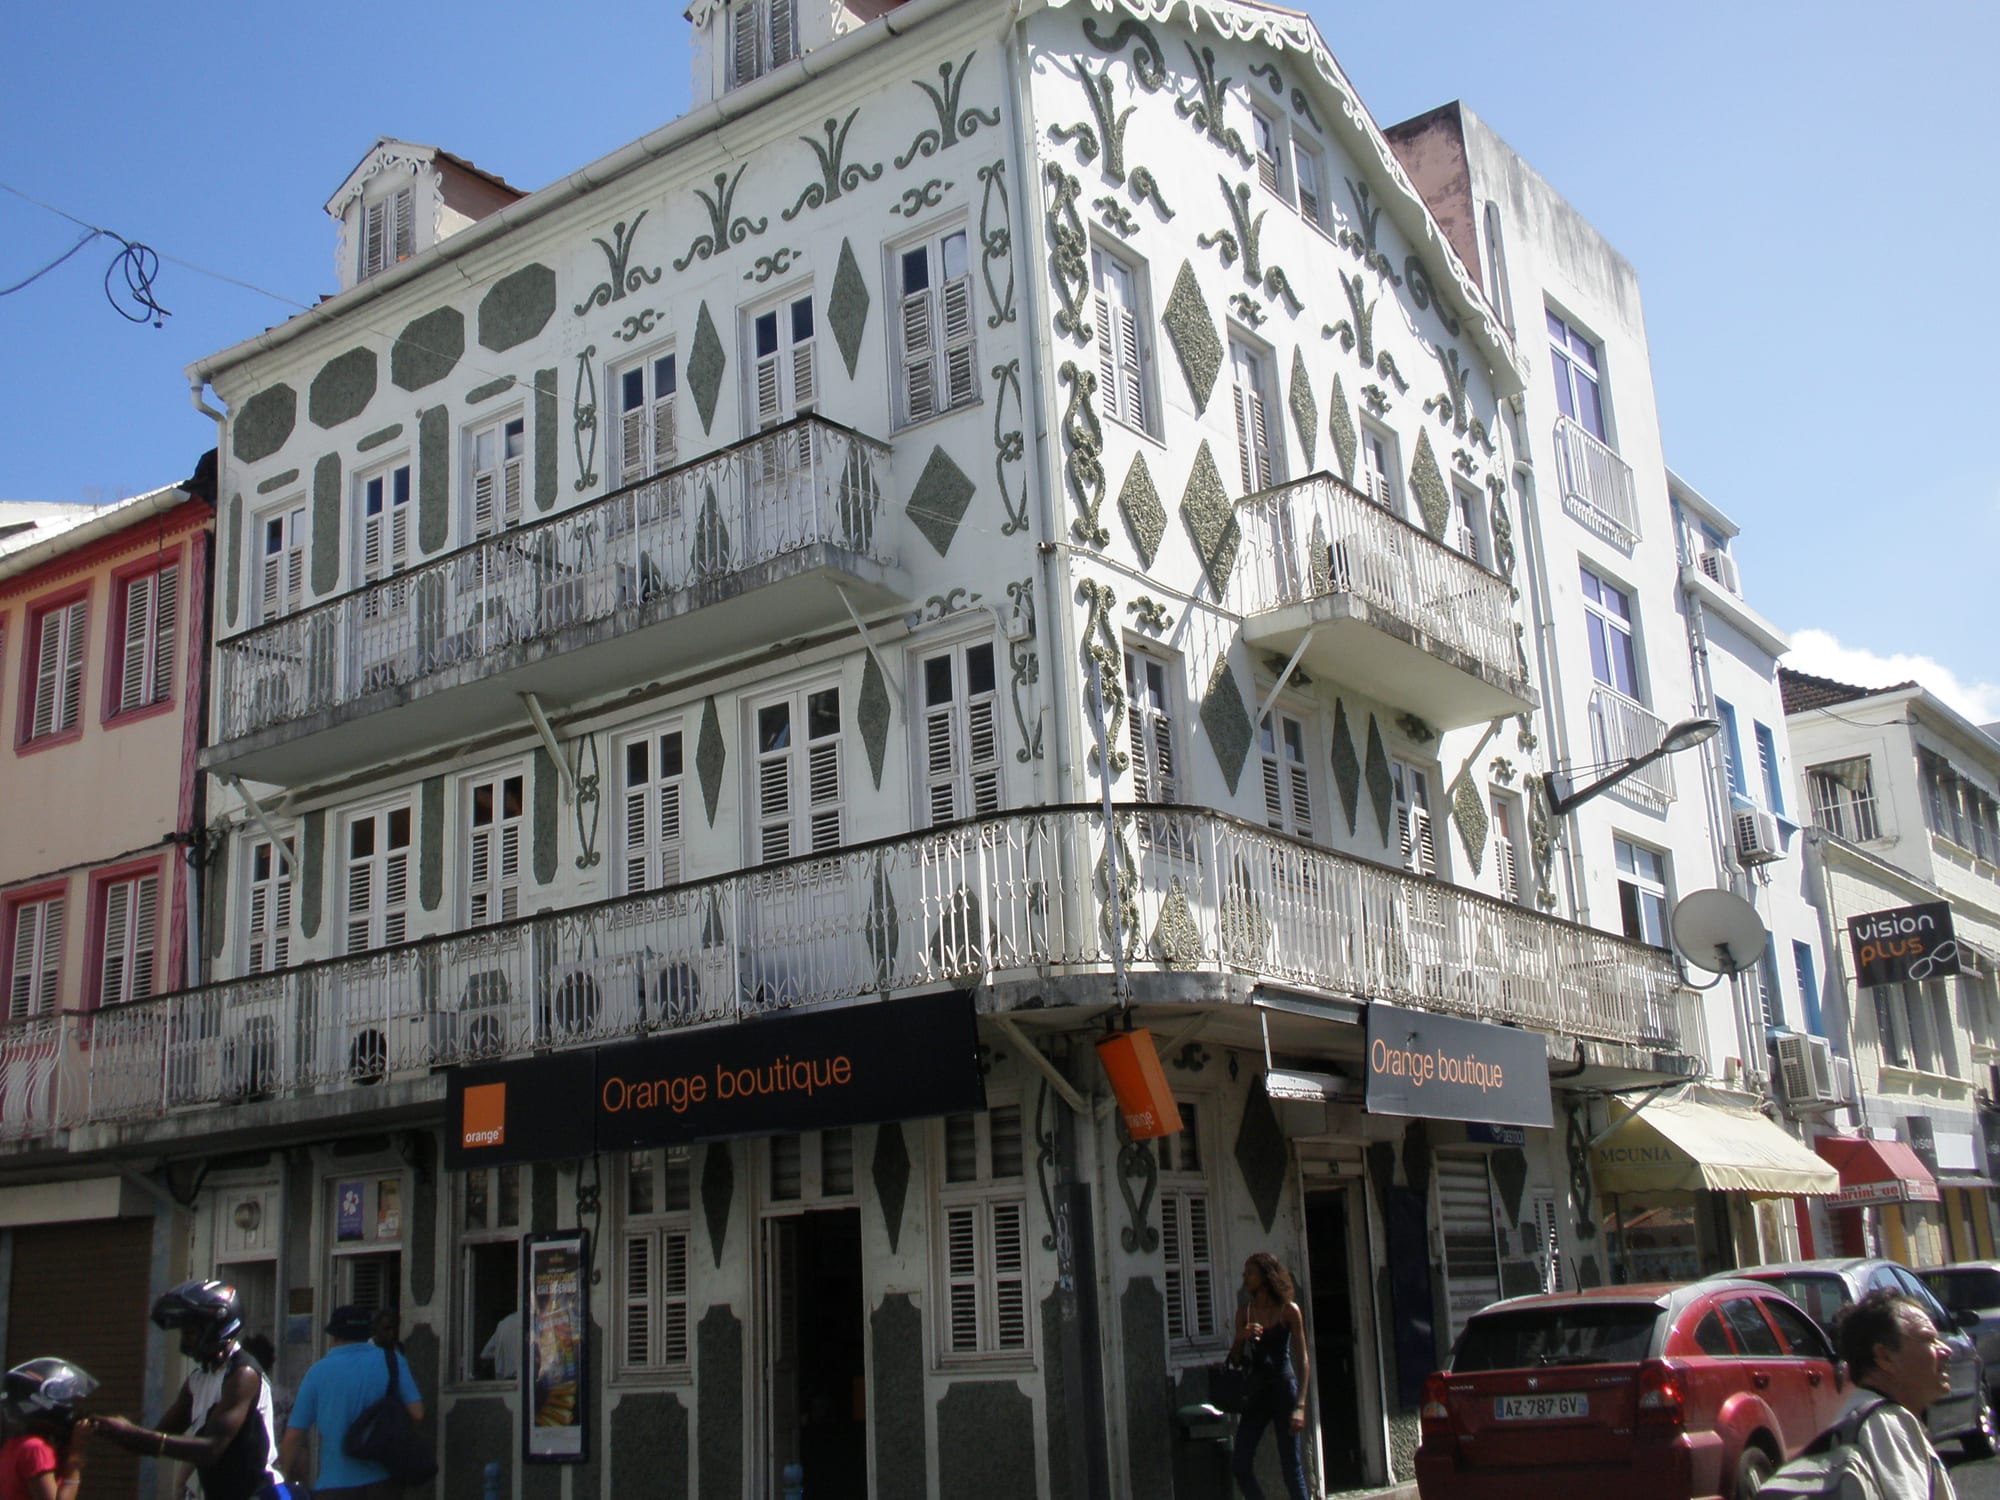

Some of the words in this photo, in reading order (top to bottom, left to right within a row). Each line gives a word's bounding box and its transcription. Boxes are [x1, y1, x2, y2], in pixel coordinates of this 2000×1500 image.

[1855, 912, 1935, 941] vision
[1371, 1038, 1435, 1087] Orange
[1437, 1048, 1504, 1094] boutique
[602, 1076, 707, 1114] Orange
[716, 1054, 852, 1097] boutique
[465, 1128, 499, 1144] orange
[1600, 1146, 1673, 1162] MOUNIA
